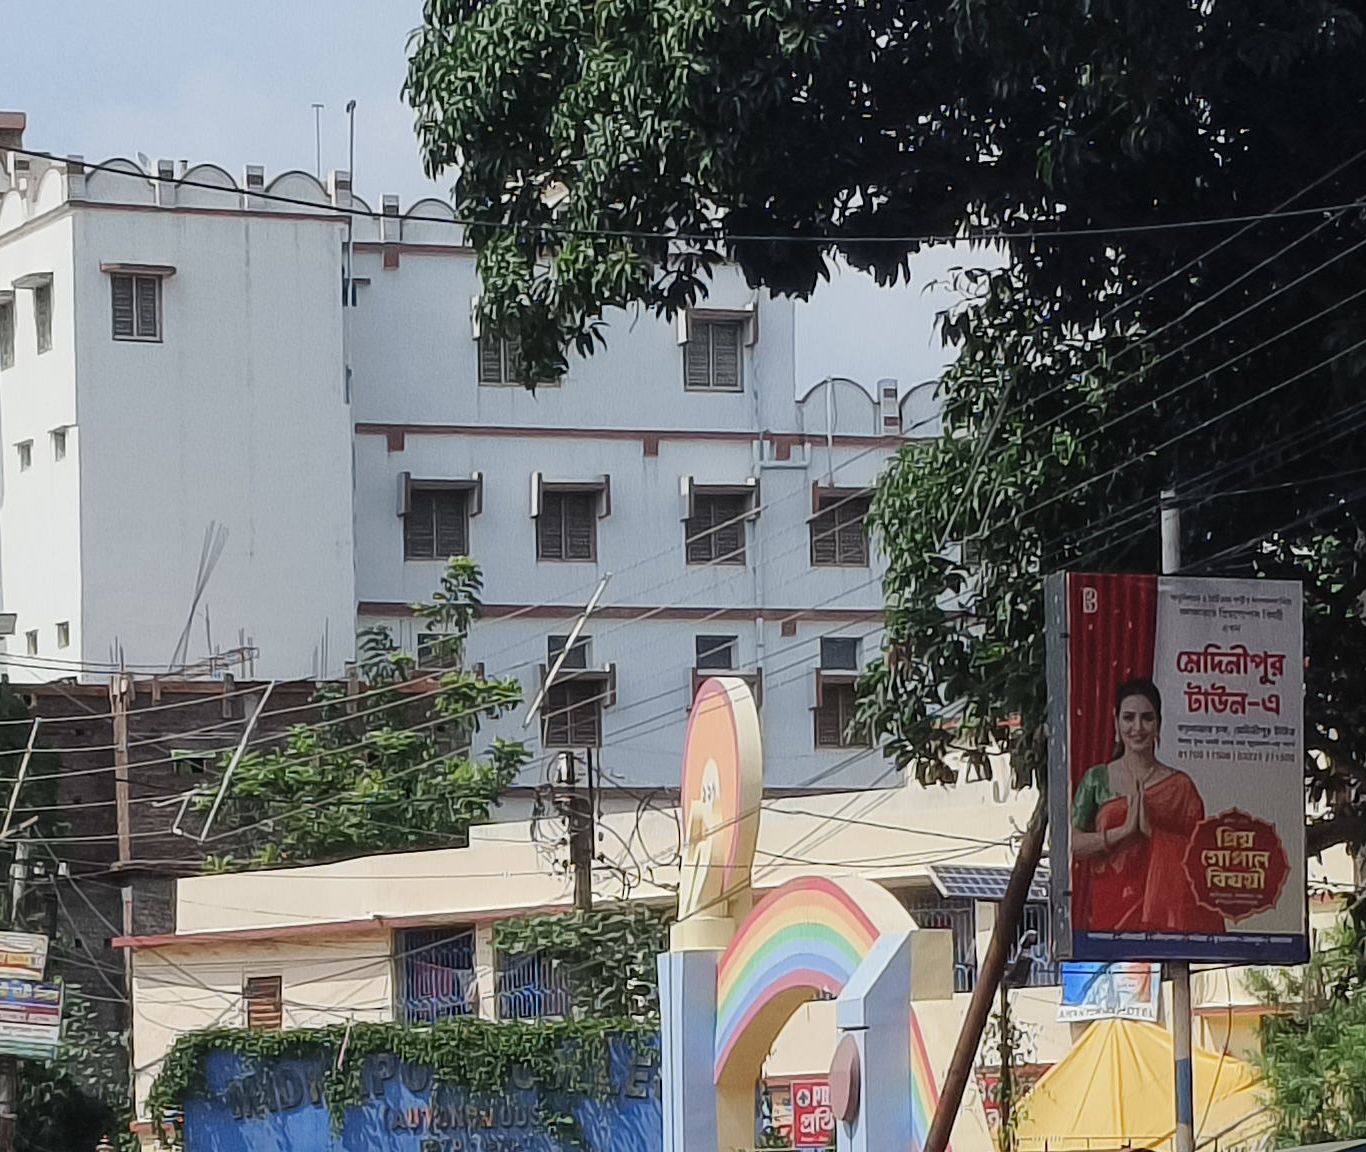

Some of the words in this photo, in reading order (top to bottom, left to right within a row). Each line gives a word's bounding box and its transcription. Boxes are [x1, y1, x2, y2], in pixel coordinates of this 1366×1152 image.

[1176, 643, 1286, 685] মেদিনীপুর
[1183, 682, 1281, 715] টাউন-এ
[1216, 826, 1256, 849] প্রিয়
[1201, 850, 1271, 869] গোপাল
[1206, 866, 1265, 889] বিষয়ী
